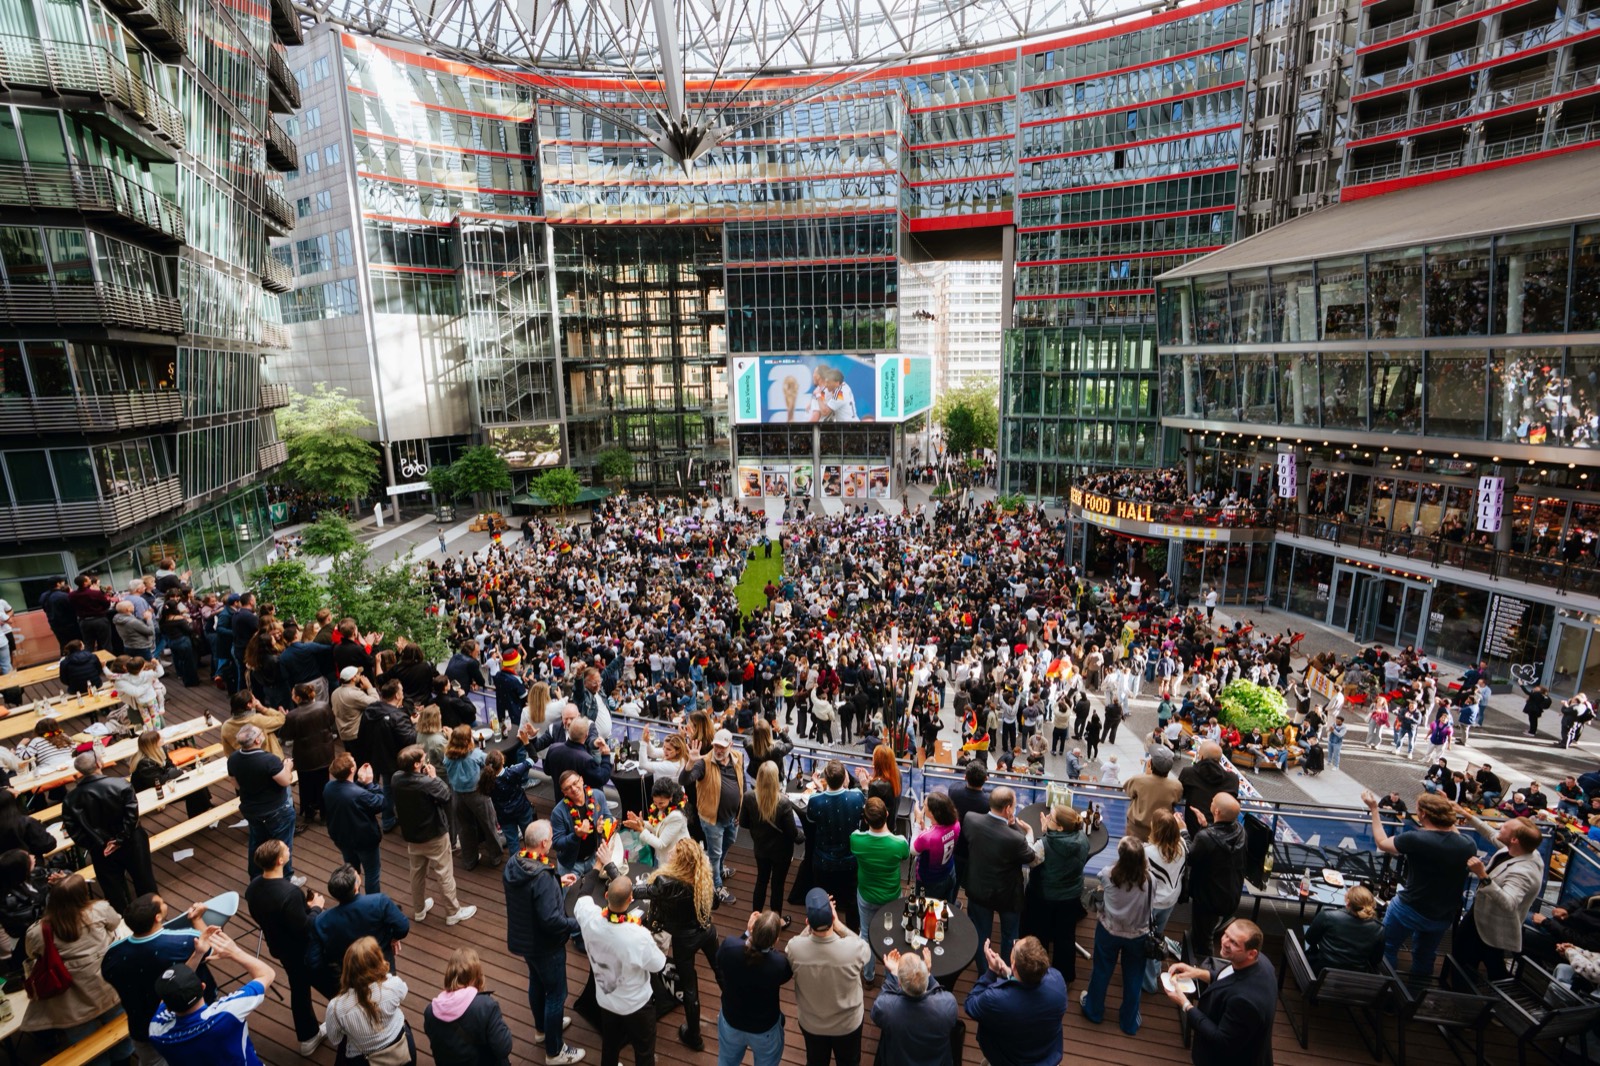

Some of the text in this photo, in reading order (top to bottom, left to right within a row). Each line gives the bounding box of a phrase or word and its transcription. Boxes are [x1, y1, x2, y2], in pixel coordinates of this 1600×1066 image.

[1280, 455, 1288, 496] FOOD
[1085, 492, 1110, 514] FOOD
[1117, 500, 1155, 523] HALL
[1482, 478, 1492, 530] HALL
[1495, 479, 1503, 530] KERB
